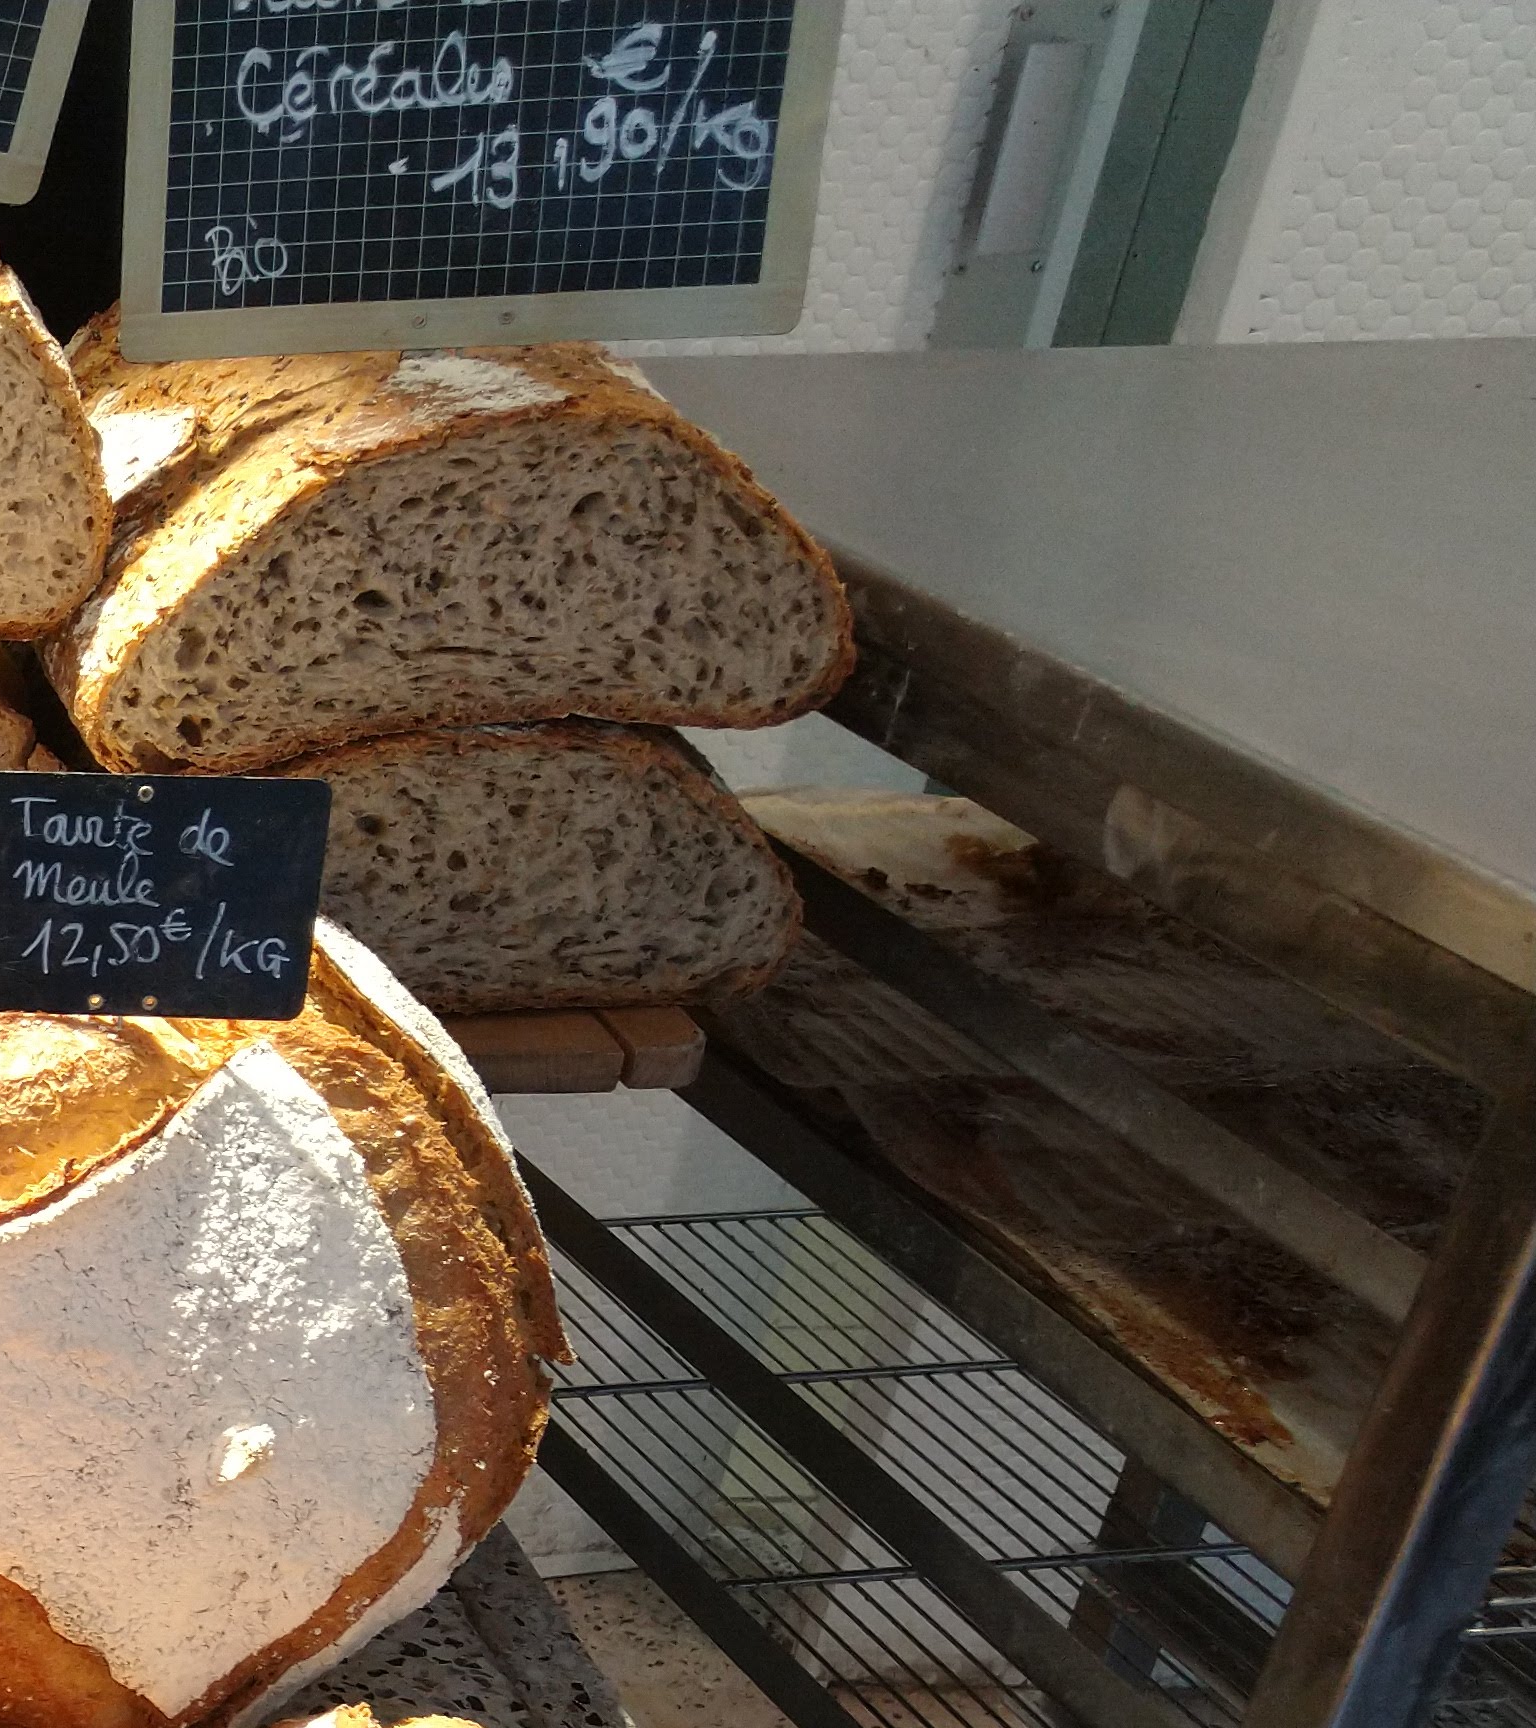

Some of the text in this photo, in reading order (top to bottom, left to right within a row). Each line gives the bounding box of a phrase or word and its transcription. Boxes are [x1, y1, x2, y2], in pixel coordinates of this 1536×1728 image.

[238, 30, 514, 122] Céréales
[205, 215, 289, 297] Bio
[10, 796, 235, 867] Tourte de
[12, 853, 161, 908] Meule
